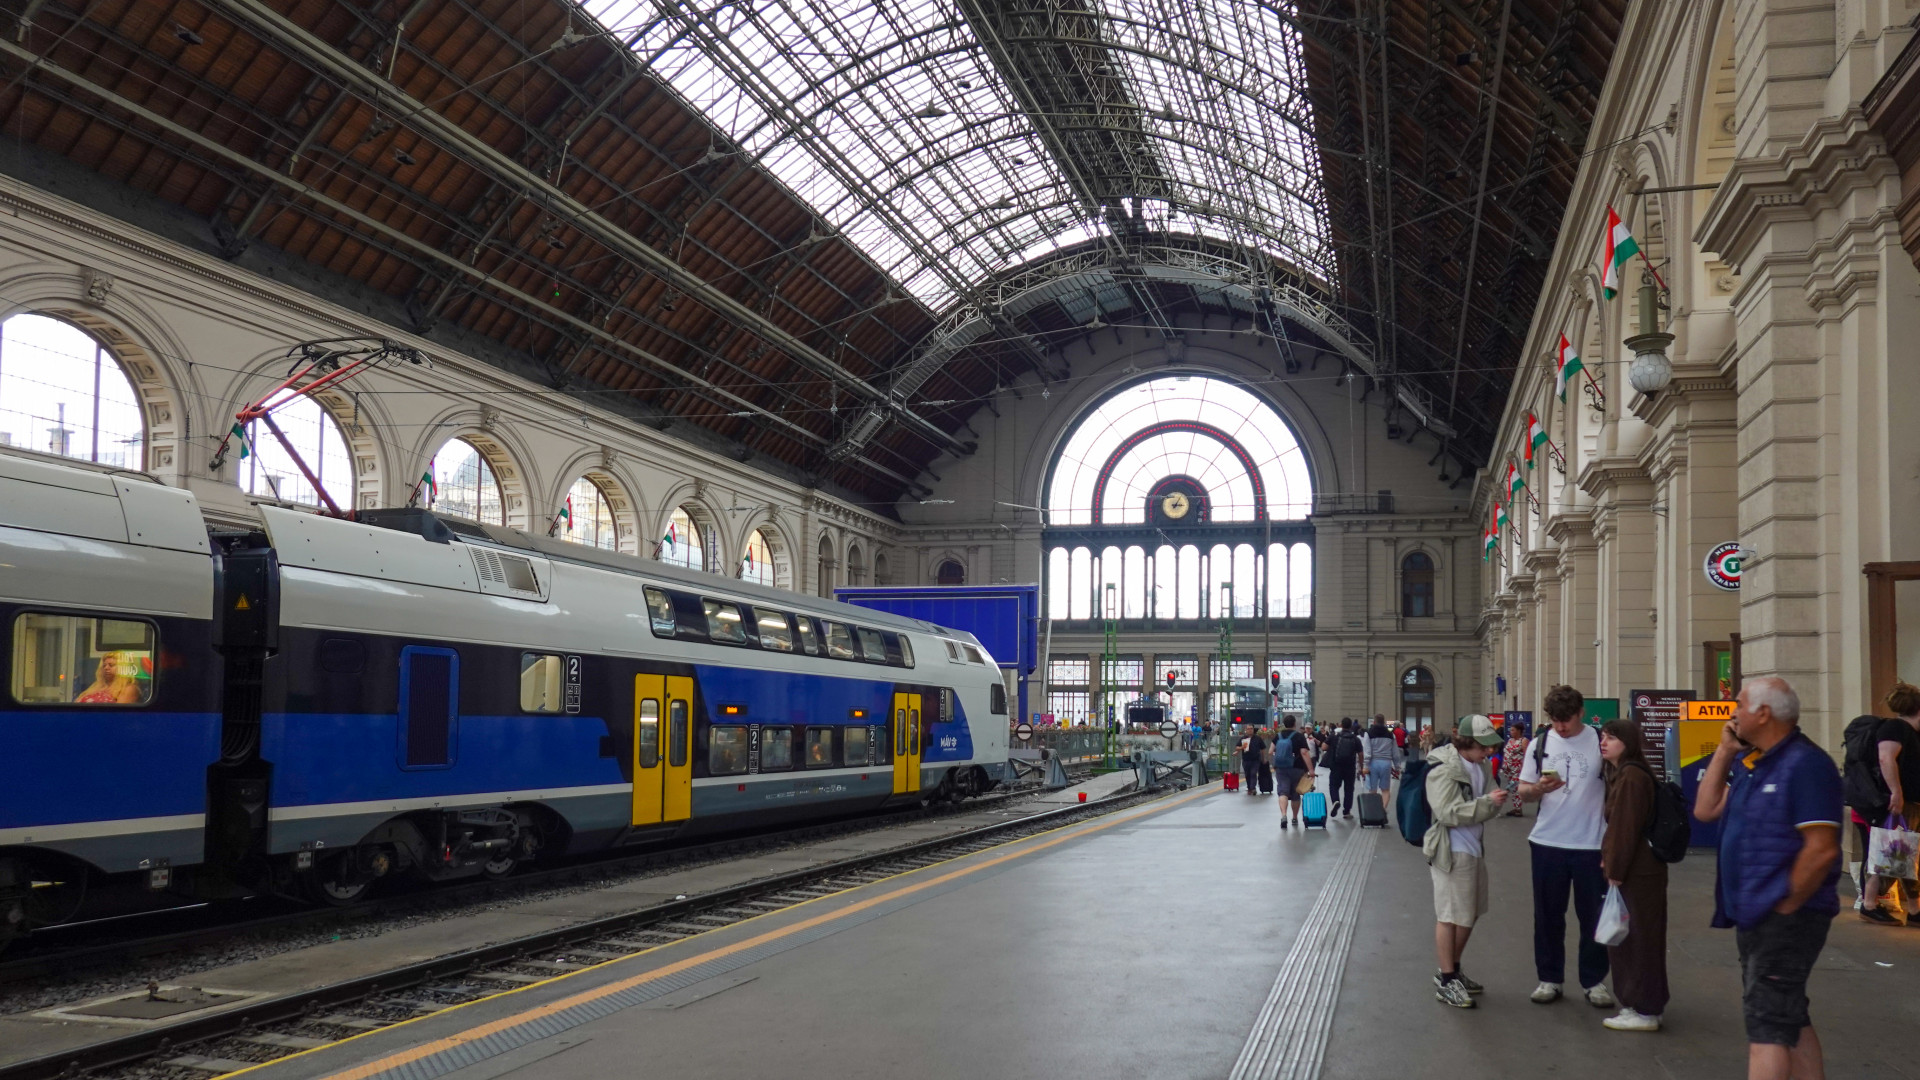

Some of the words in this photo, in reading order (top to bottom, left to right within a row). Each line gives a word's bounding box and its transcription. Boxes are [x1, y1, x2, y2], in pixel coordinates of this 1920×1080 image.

[1728, 561, 1739, 570] T
[570, 658, 578, 675] 2
[1698, 705, 1730, 716] ATM
[752, 731, 757, 744] 2
